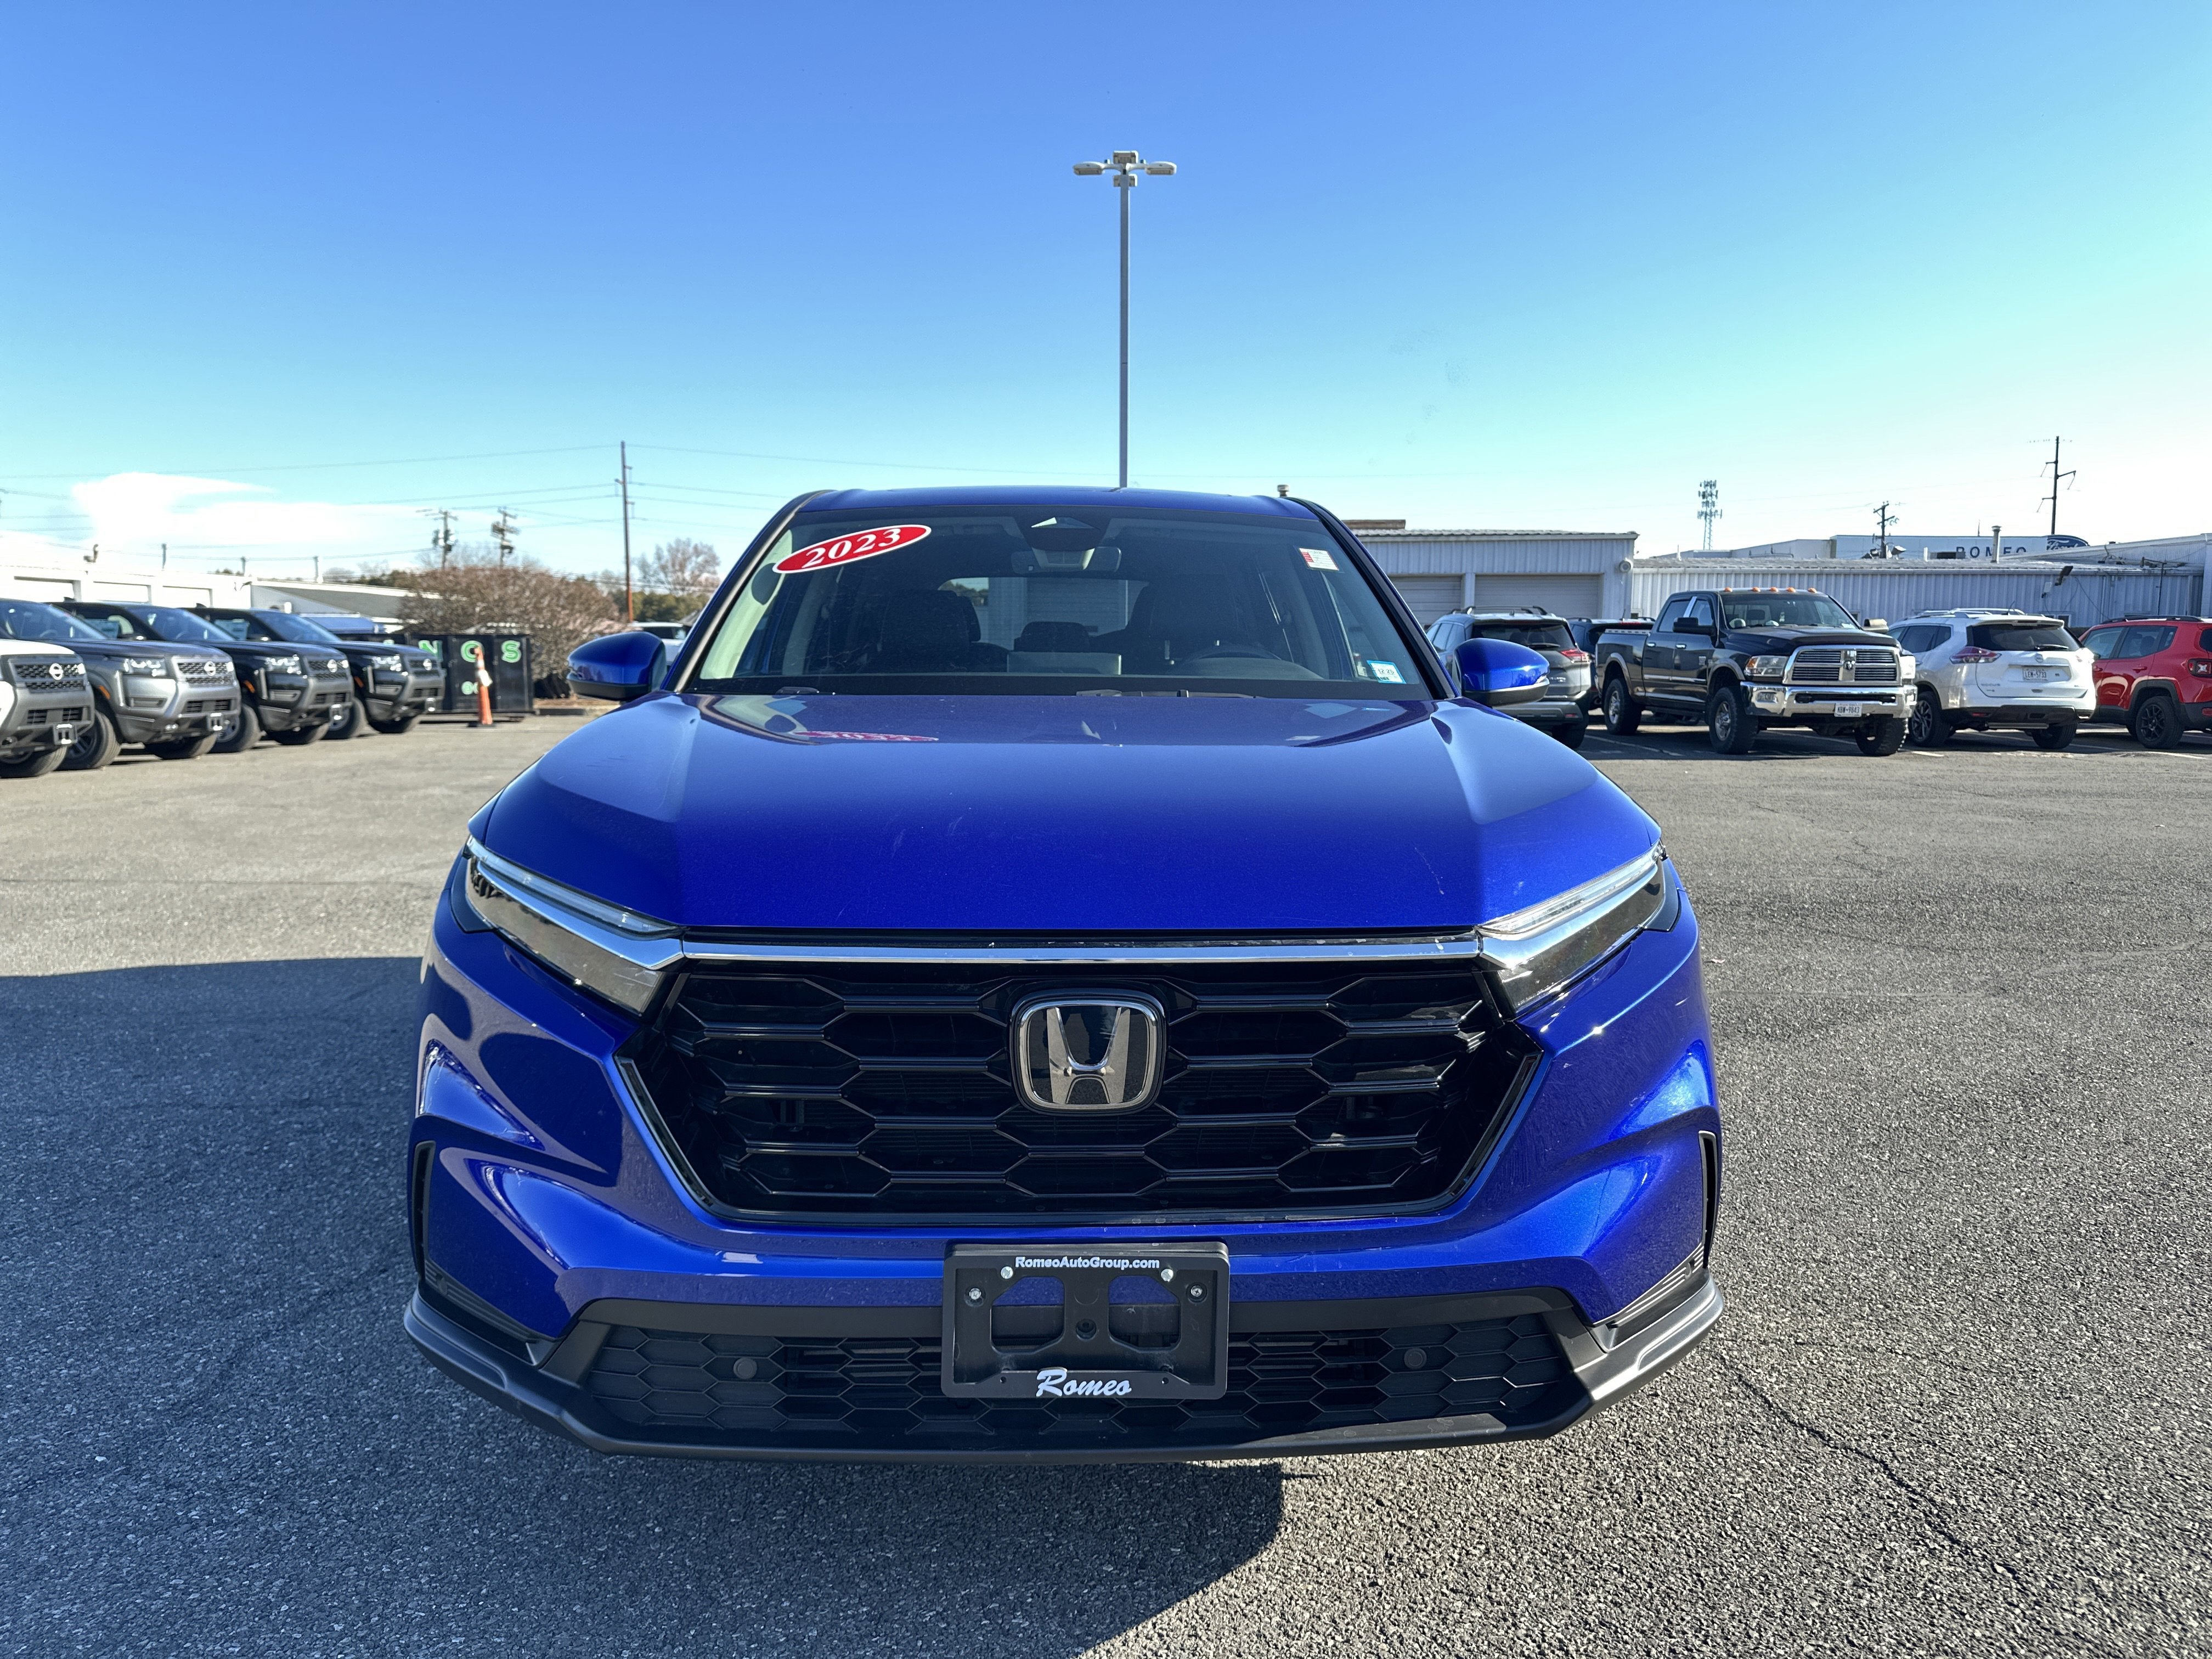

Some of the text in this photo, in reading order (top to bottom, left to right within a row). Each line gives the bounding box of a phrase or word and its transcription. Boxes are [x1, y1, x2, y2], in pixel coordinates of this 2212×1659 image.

[802, 528, 901, 568] 2023
[1015, 1256, 1160, 1270] RomeoAutoGroup.com
[1036, 1369, 1132, 1397] Romeo
